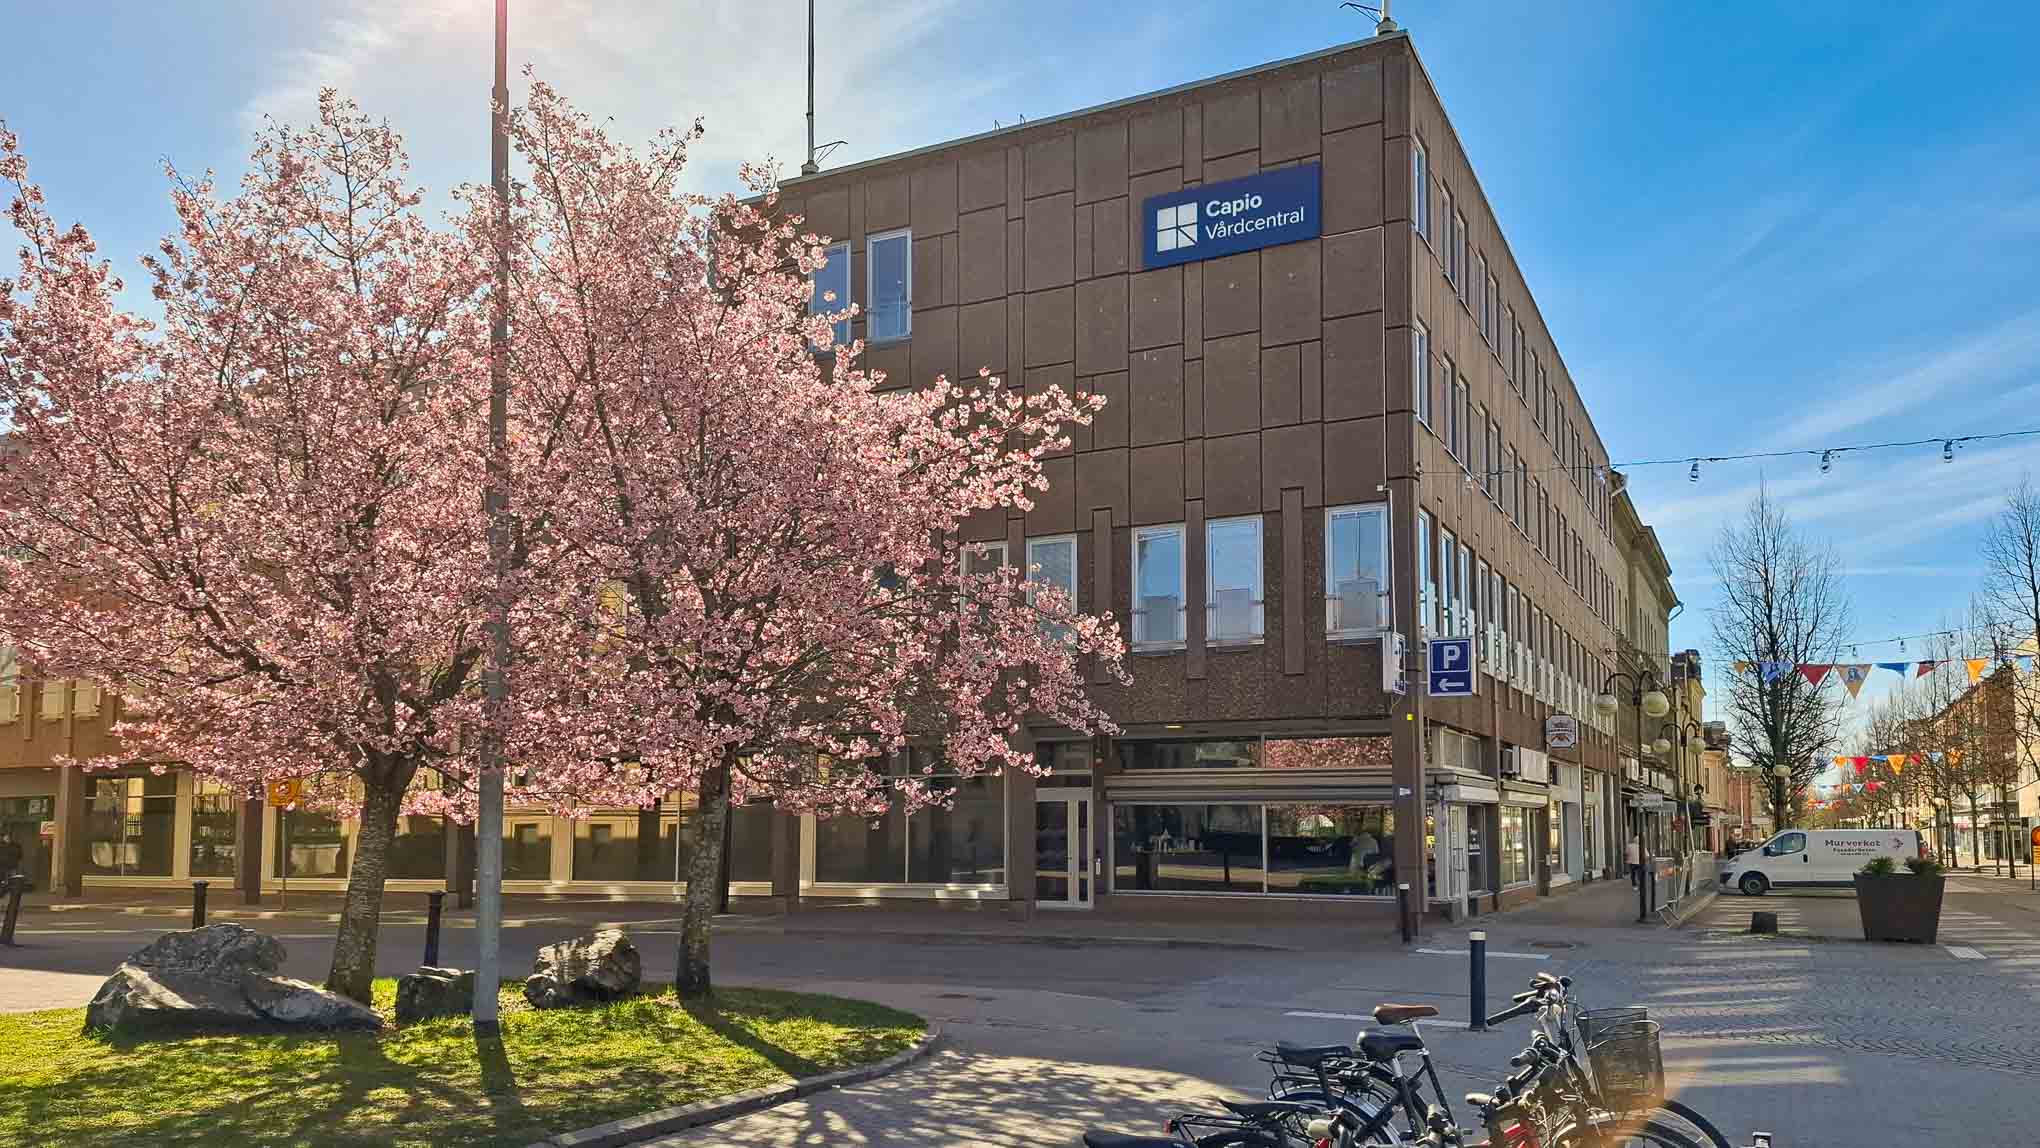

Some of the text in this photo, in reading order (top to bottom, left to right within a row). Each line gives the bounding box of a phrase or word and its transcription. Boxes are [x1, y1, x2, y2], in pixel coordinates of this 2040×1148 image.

[1205, 193, 1263, 217] Capio
[1205, 207, 1305, 240] Vårdcentral
[1443, 645, 1461, 669] P
